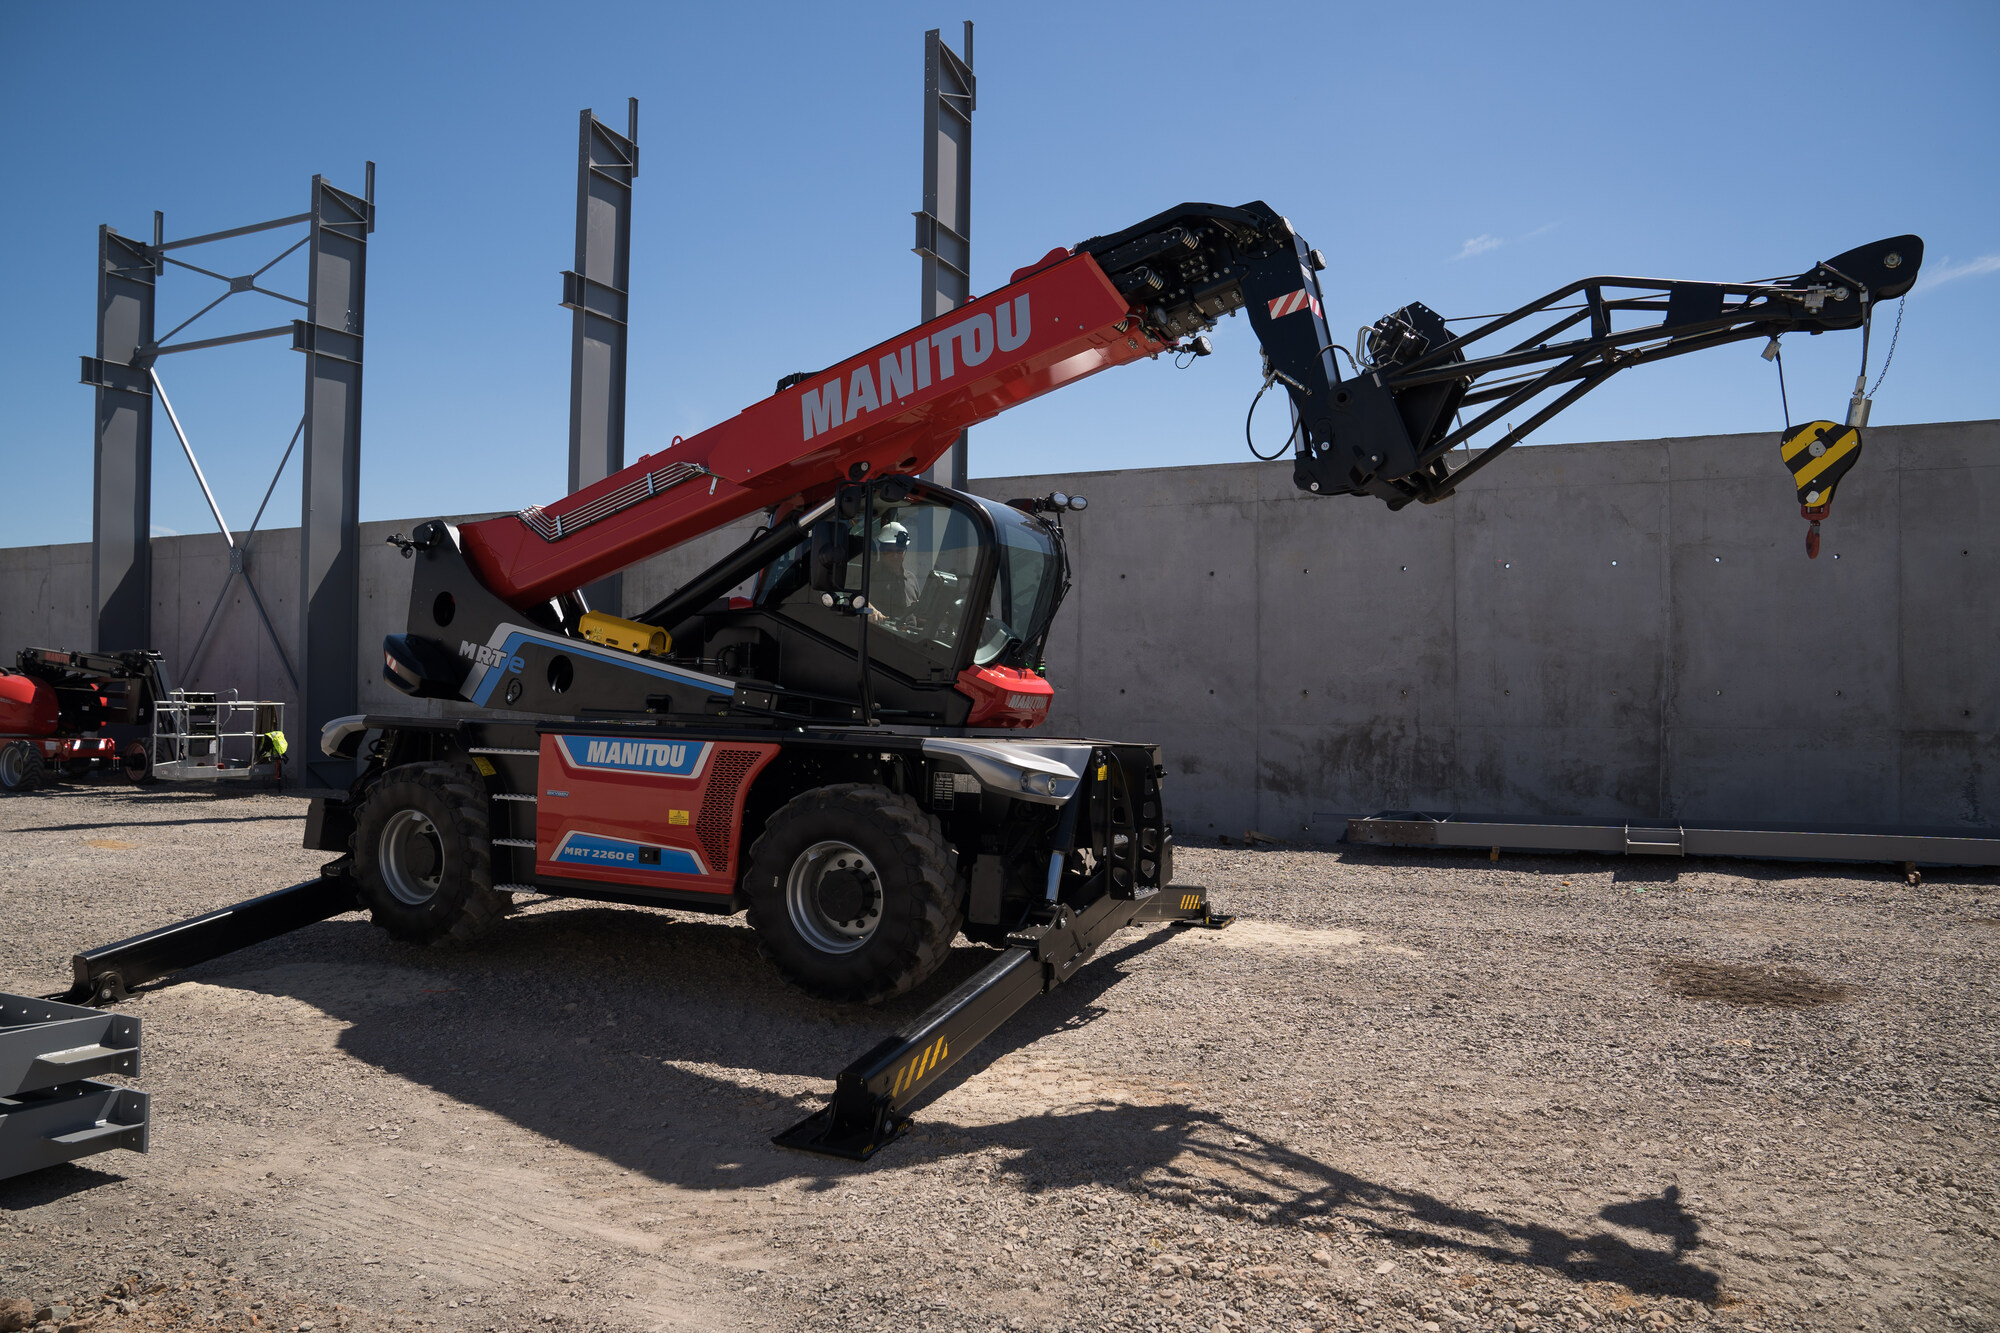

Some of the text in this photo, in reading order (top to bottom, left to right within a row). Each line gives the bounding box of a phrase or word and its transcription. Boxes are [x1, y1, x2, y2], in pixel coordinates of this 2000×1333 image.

[801, 293, 1031, 441] MANITOU
[1008, 694, 1048, 709] MANITOU
[587, 741, 686, 767] MANITOU
[564, 847, 590, 857] MRT
